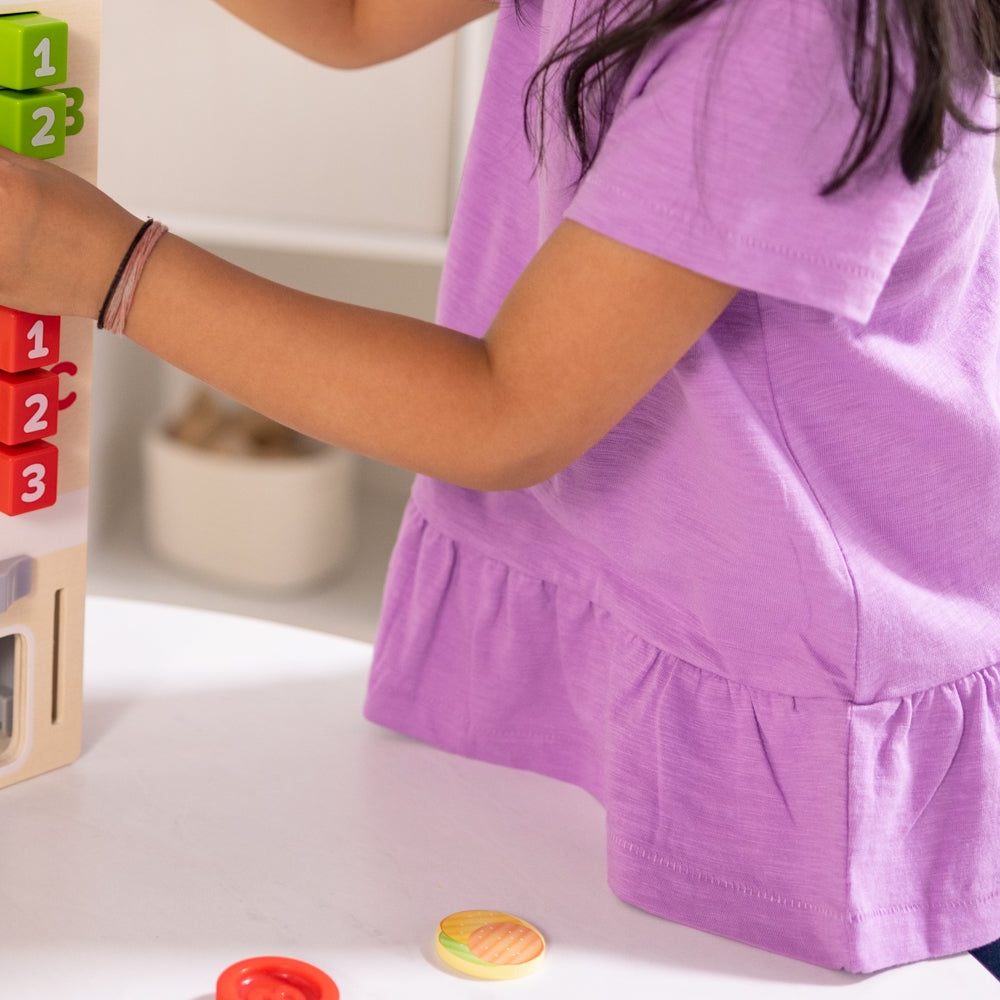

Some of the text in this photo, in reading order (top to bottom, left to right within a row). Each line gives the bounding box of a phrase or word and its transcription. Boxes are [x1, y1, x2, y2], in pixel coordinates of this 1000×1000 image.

[33, 37, 57, 78] 1
[31, 106, 56, 147] 2
[26, 319, 49, 360] 1
[23, 393, 49, 434] 2
[20, 463, 46, 503] 3
